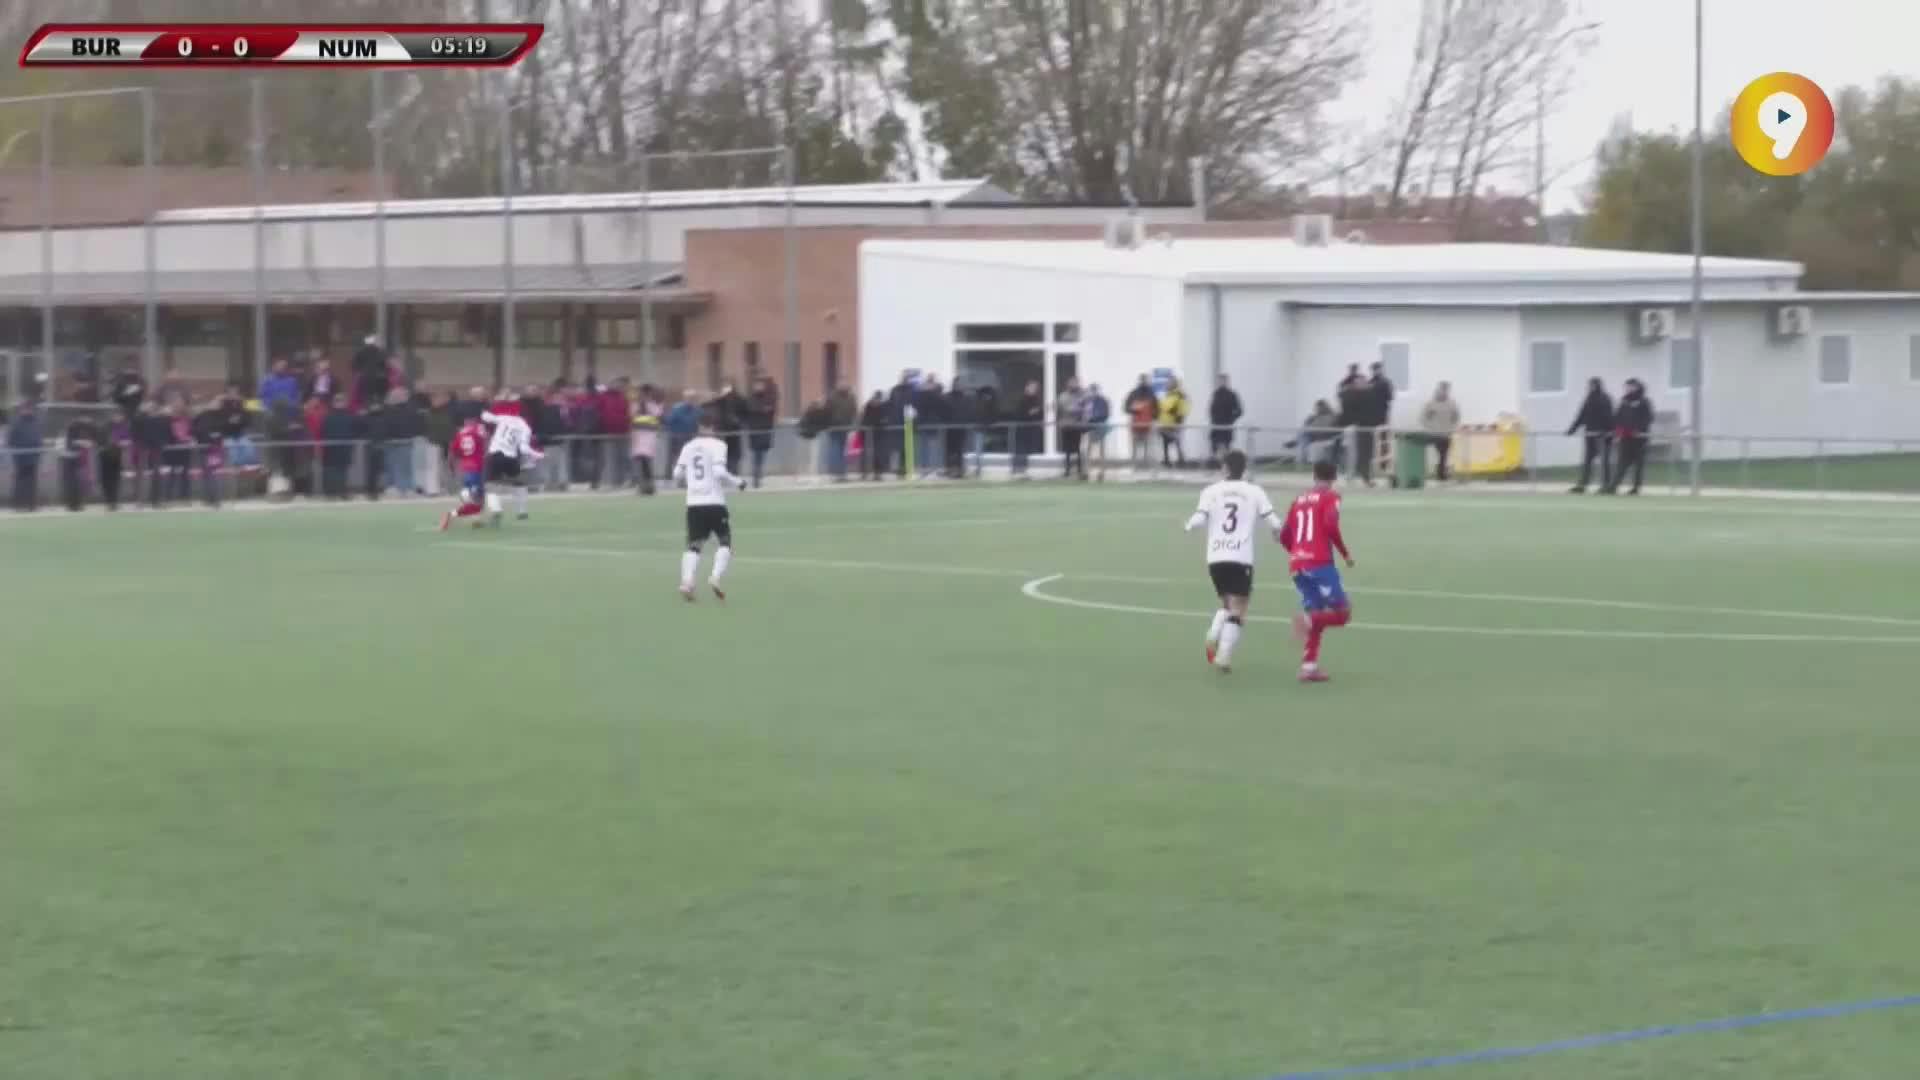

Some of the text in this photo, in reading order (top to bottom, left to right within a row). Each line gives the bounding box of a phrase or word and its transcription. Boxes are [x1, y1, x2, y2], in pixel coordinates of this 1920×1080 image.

[693, 455, 706, 481] 5
[1221, 502, 1239, 534] 3
[1295, 507, 1315, 544] 11
